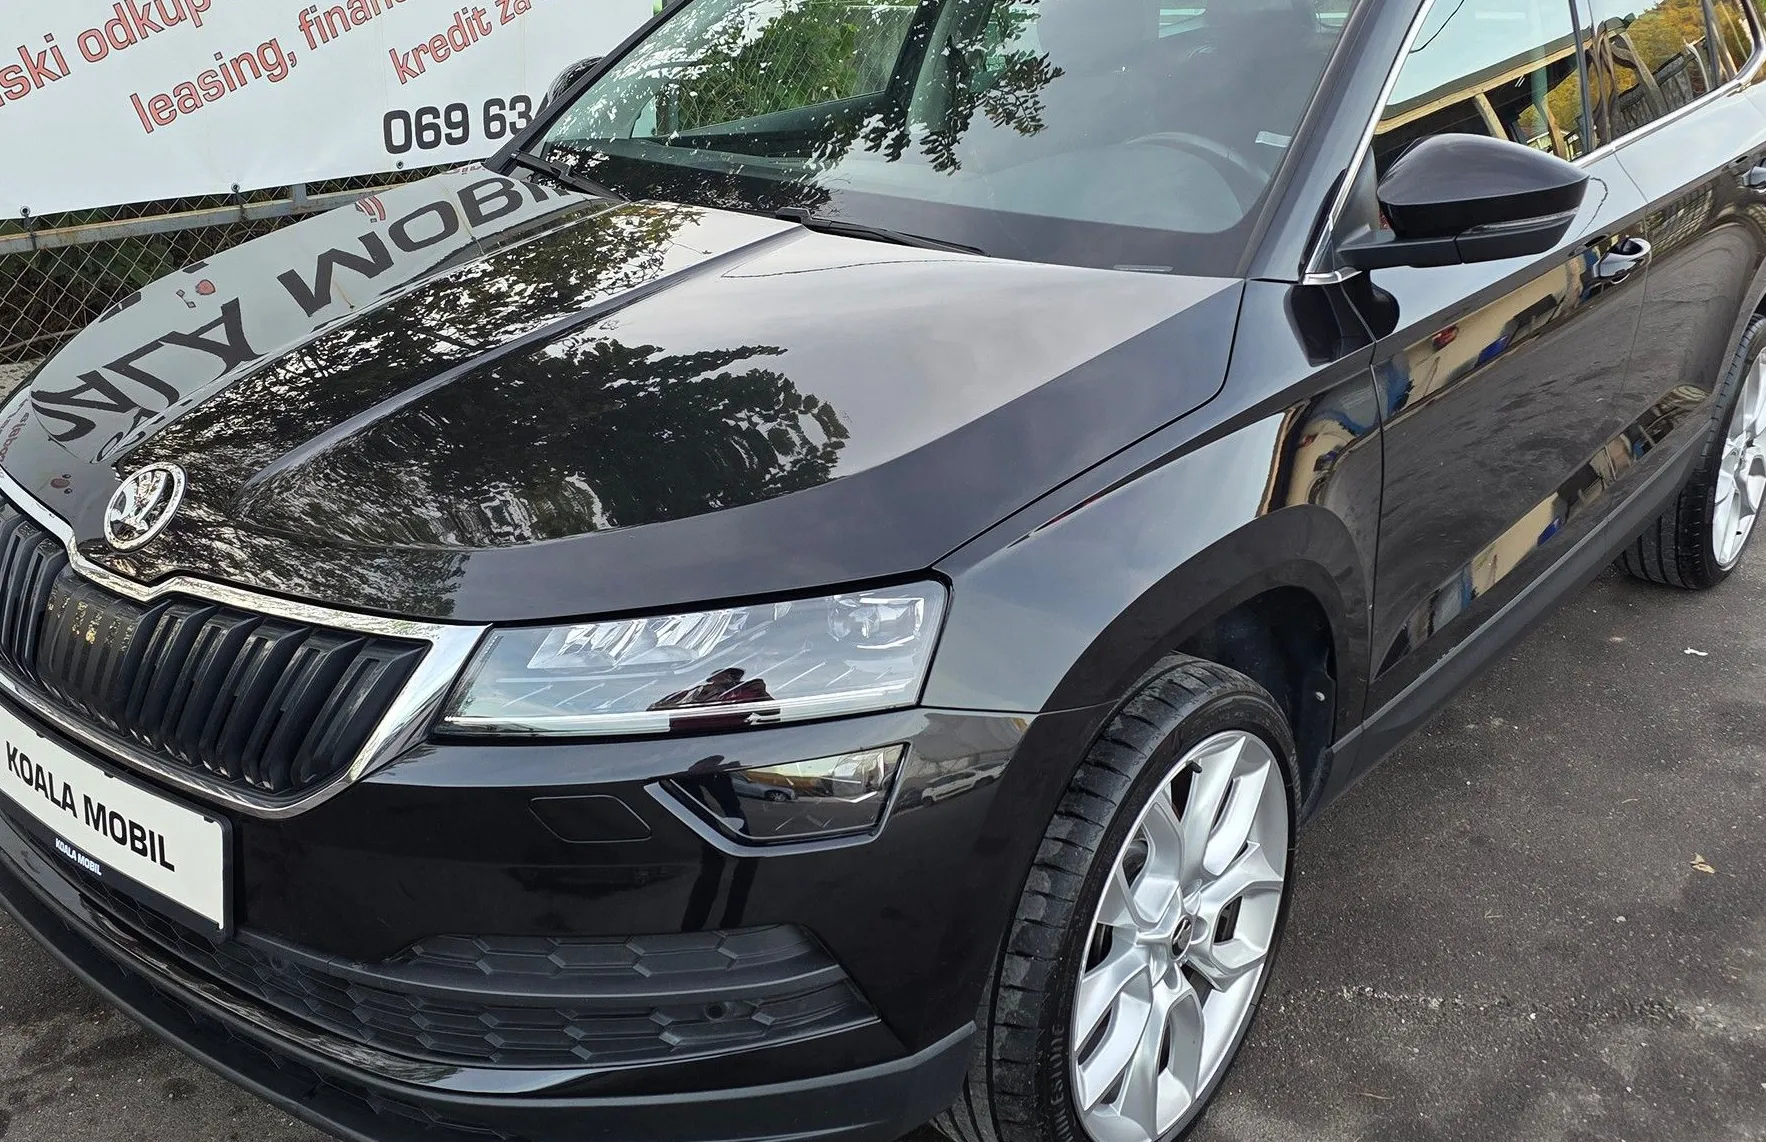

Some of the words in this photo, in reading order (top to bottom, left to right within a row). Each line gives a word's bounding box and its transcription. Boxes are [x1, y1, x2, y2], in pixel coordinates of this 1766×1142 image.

[0, 33, 71, 107] ski
[389, 7, 492, 84] kredit
[130, 38, 298, 134] leasing,
[383, 109, 470, 154] 069
[6, 741, 78, 819] KOALA
[83, 793, 175, 872] MOBIL
[55, 838, 77, 861] KOALA
[77, 853, 102, 876] MOBIL
